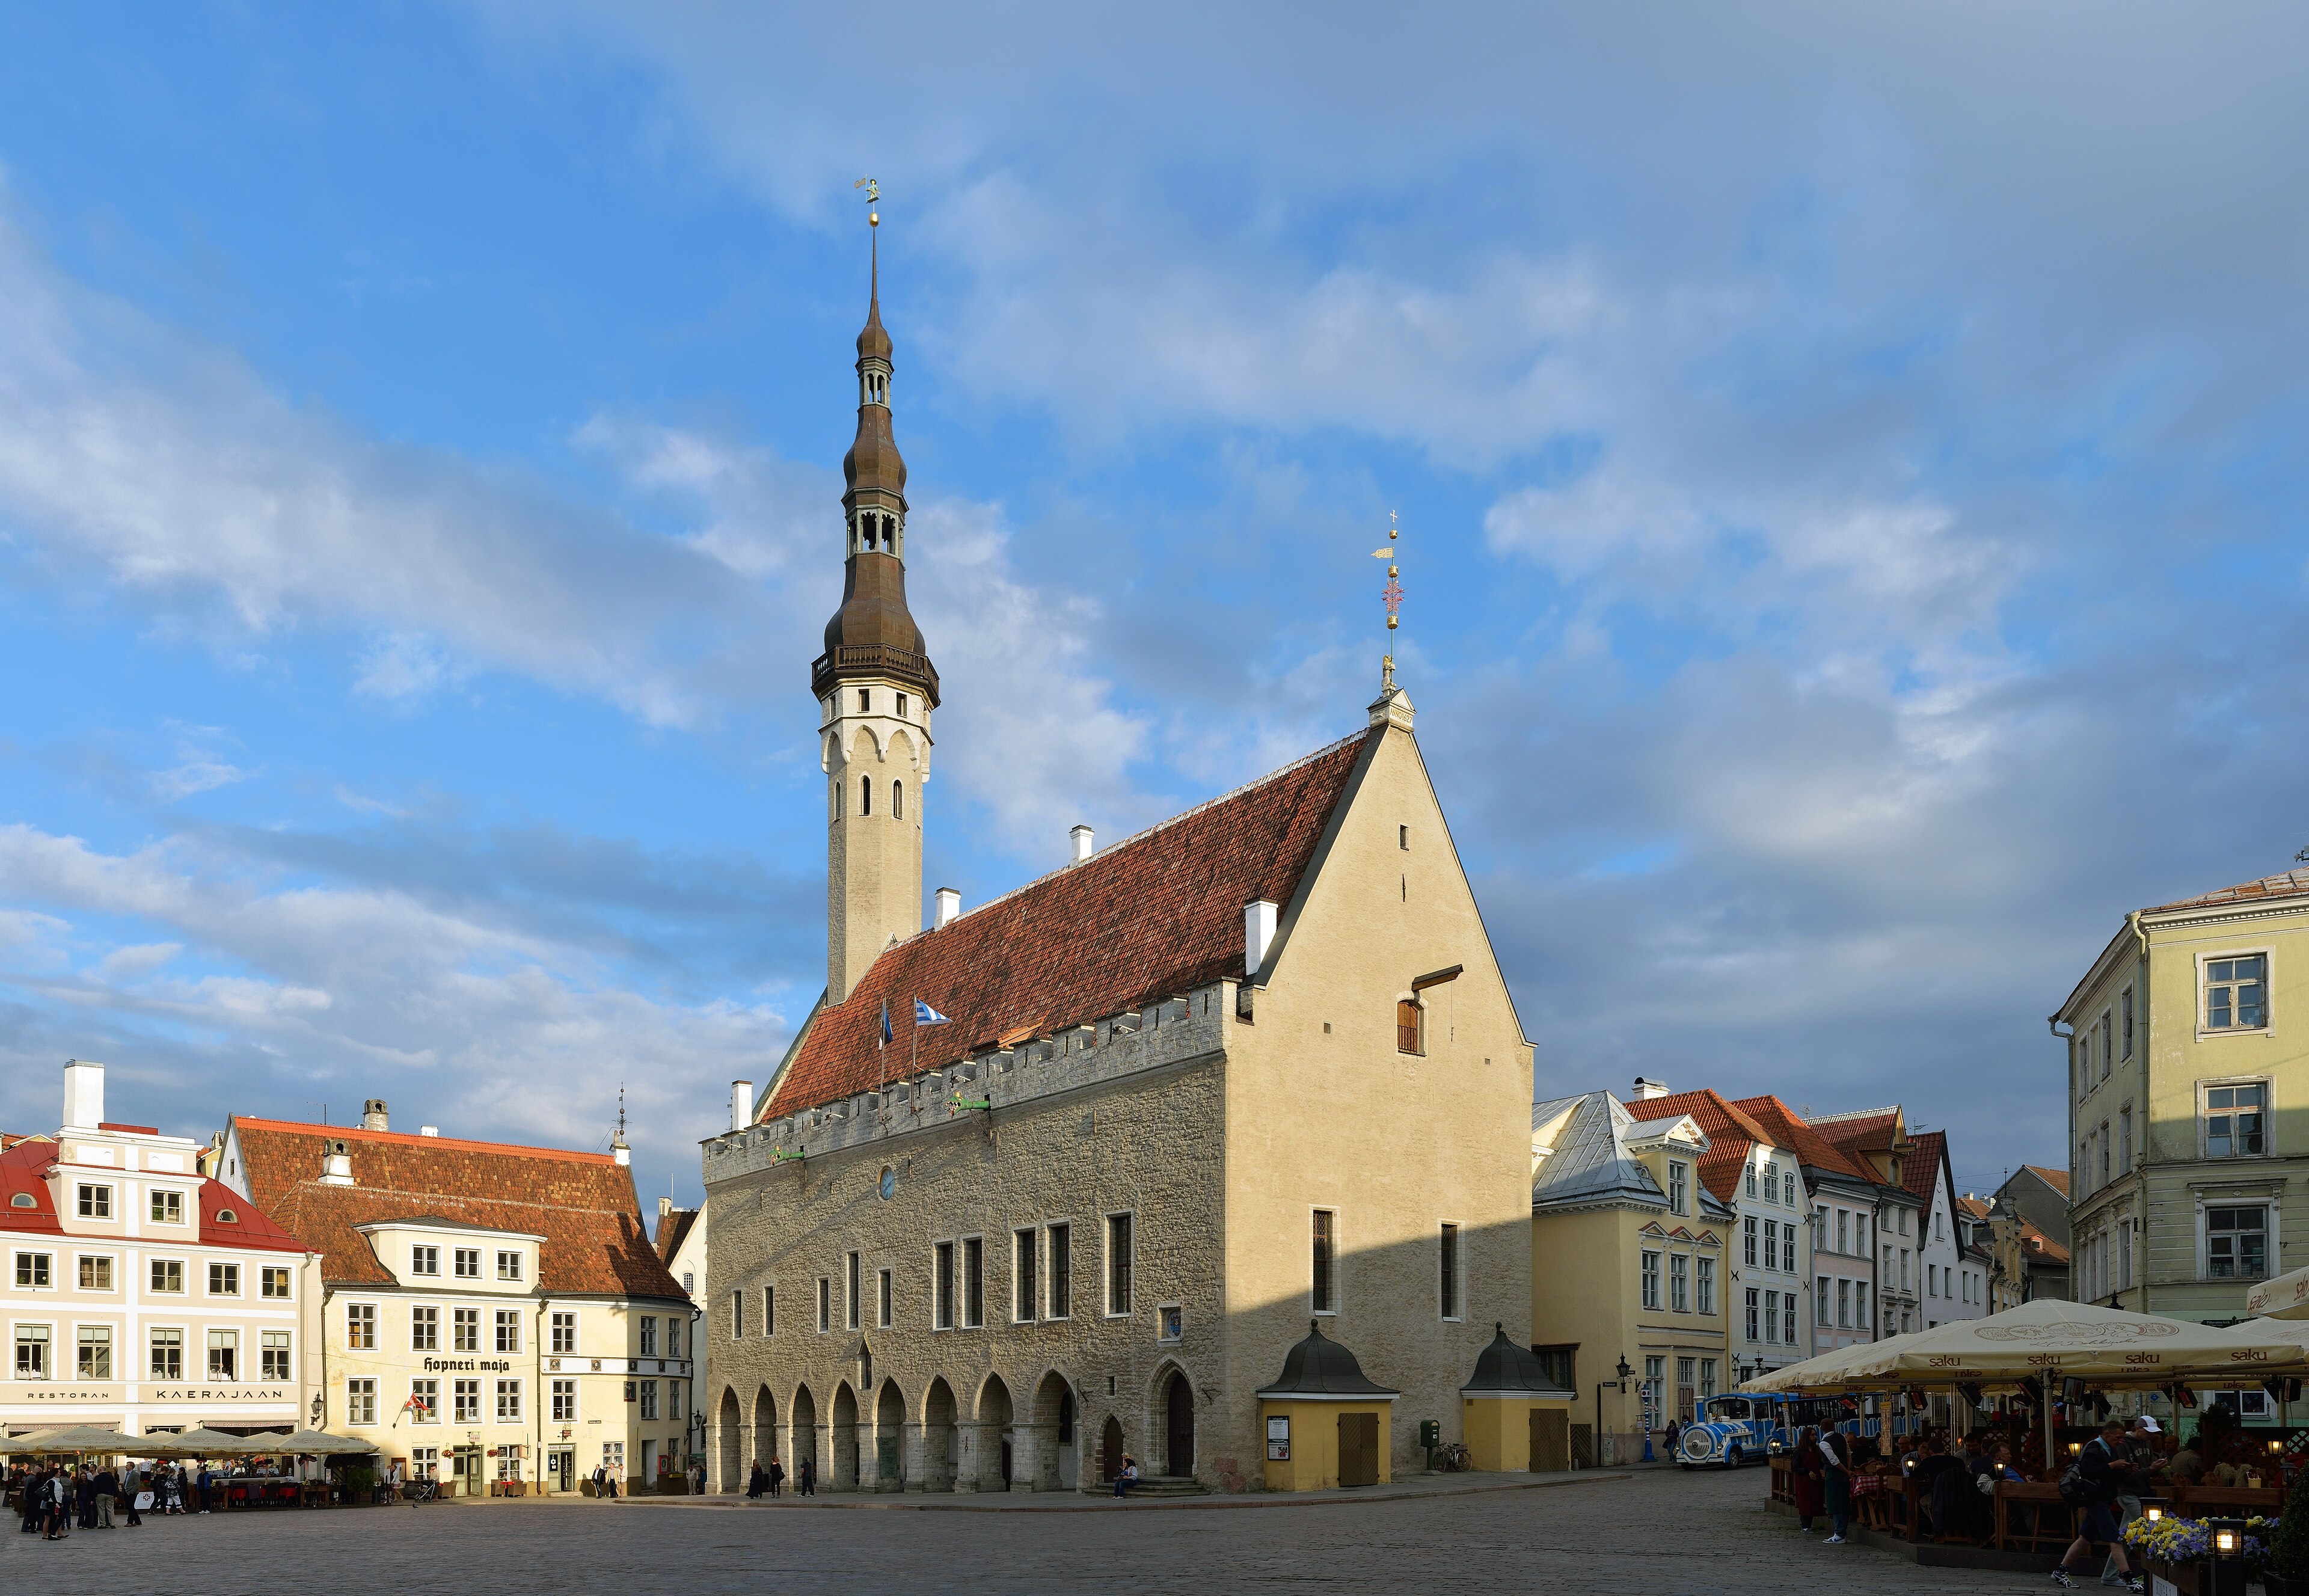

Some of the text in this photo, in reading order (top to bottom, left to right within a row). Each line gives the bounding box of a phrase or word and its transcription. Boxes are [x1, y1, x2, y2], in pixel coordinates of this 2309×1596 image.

[2293, 1273, 2309, 1301] sak
[1929, 1354, 1961, 1366] saku
[2027, 1353, 2061, 1365] saku
[2125, 1351, 2160, 1364] saku
[2231, 1348, 2268, 1361] saku
[424, 1357, 509, 1373] Hopneri maja
[157, 1390, 282, 1399] KAERAJAAN
